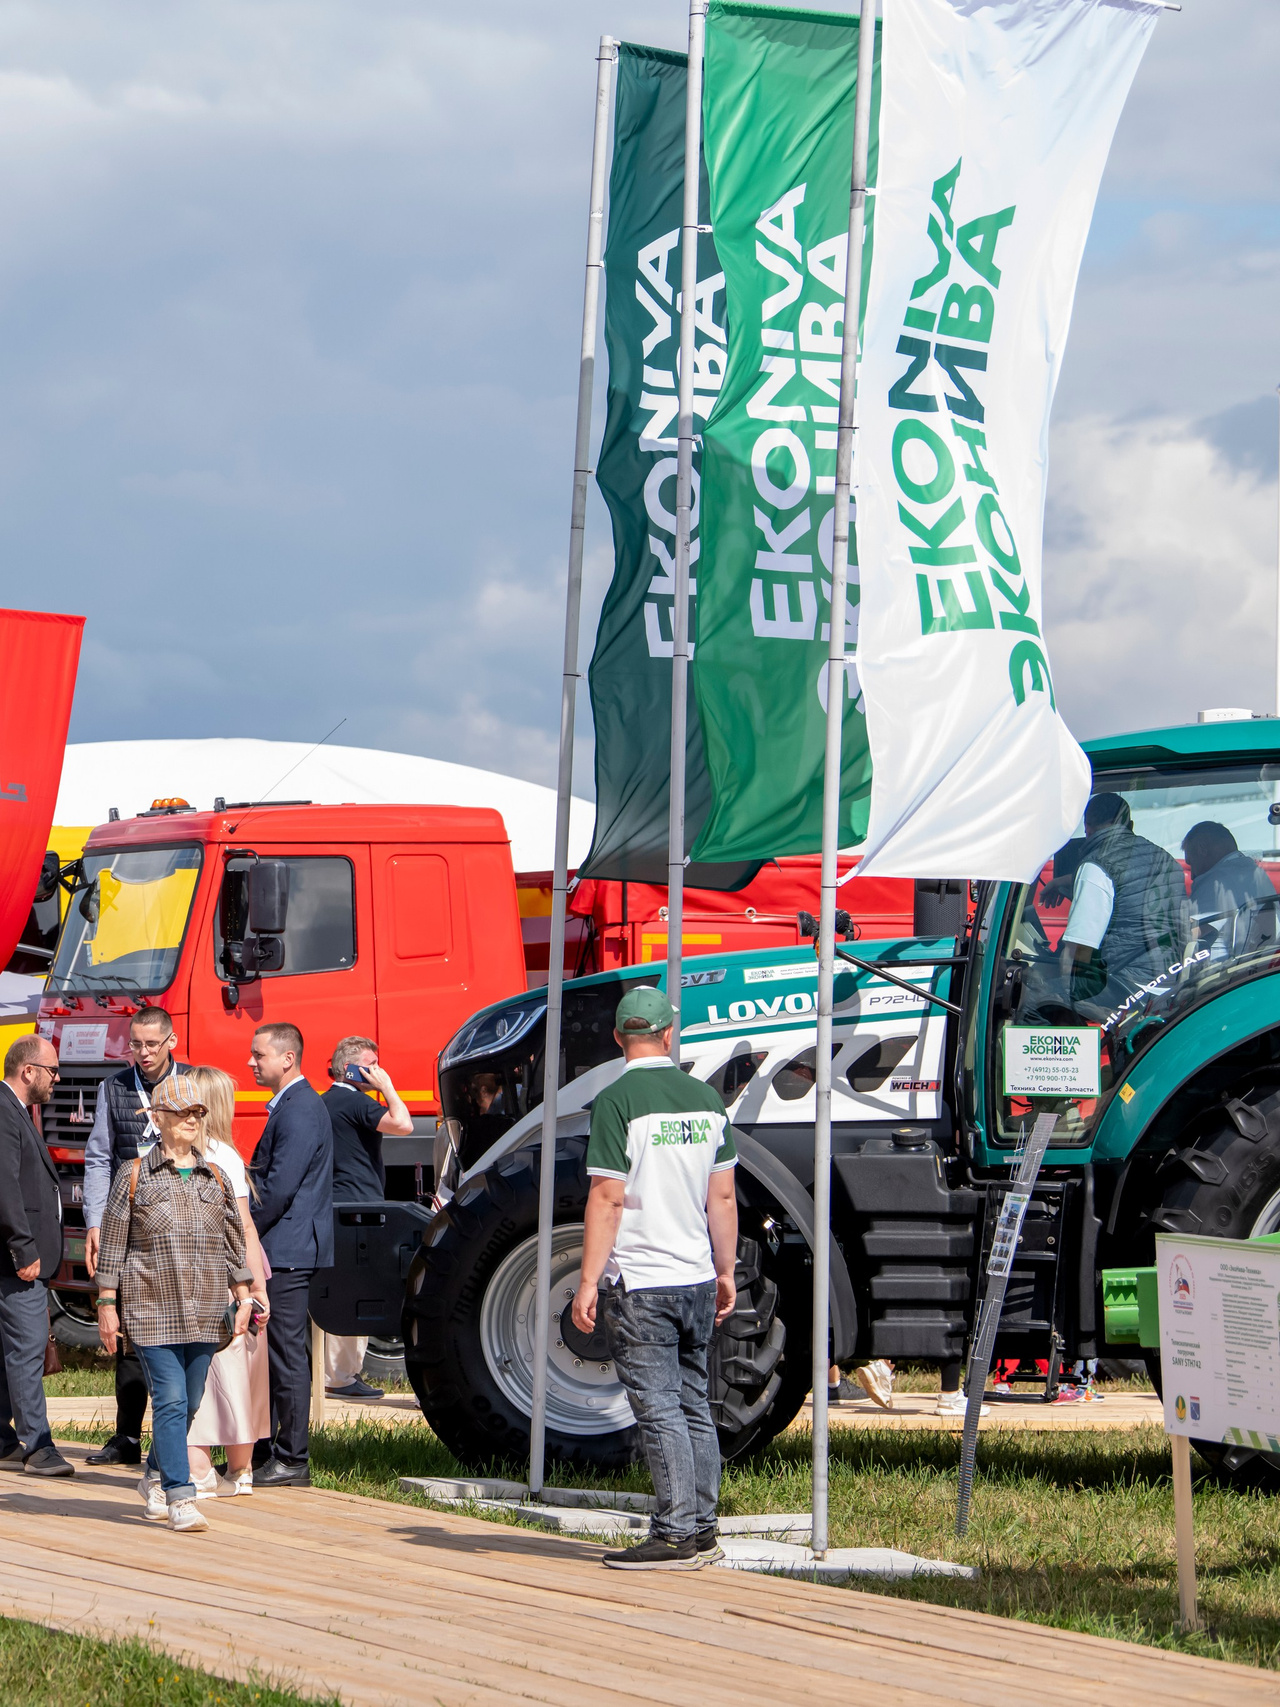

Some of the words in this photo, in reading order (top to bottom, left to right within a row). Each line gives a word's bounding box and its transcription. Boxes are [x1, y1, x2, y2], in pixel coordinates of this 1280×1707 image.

[889, 155, 996, 636] EKONIVA
[750, 182, 817, 641] EKONIVA
[935, 203, 1057, 715] ЭКОНИВА
[1168, 949, 1211, 975] CAB
[707, 991, 819, 1026] LOVO
[1029, 1035, 1081, 1046] EKONIVA
[1022, 1045, 1077, 1055] ЭКОНИВА
[1032, 1066, 1051, 1074] (4912)
[892, 1082, 940, 1090] WEICHAI
[1038, 1085, 1062, 1093] Сервис
[660, 1119, 711, 1133] EKONIVA
[651, 1132, 708, 1146] ЭКОНИВА
[1172, 1357, 1184, 1366] SANY
